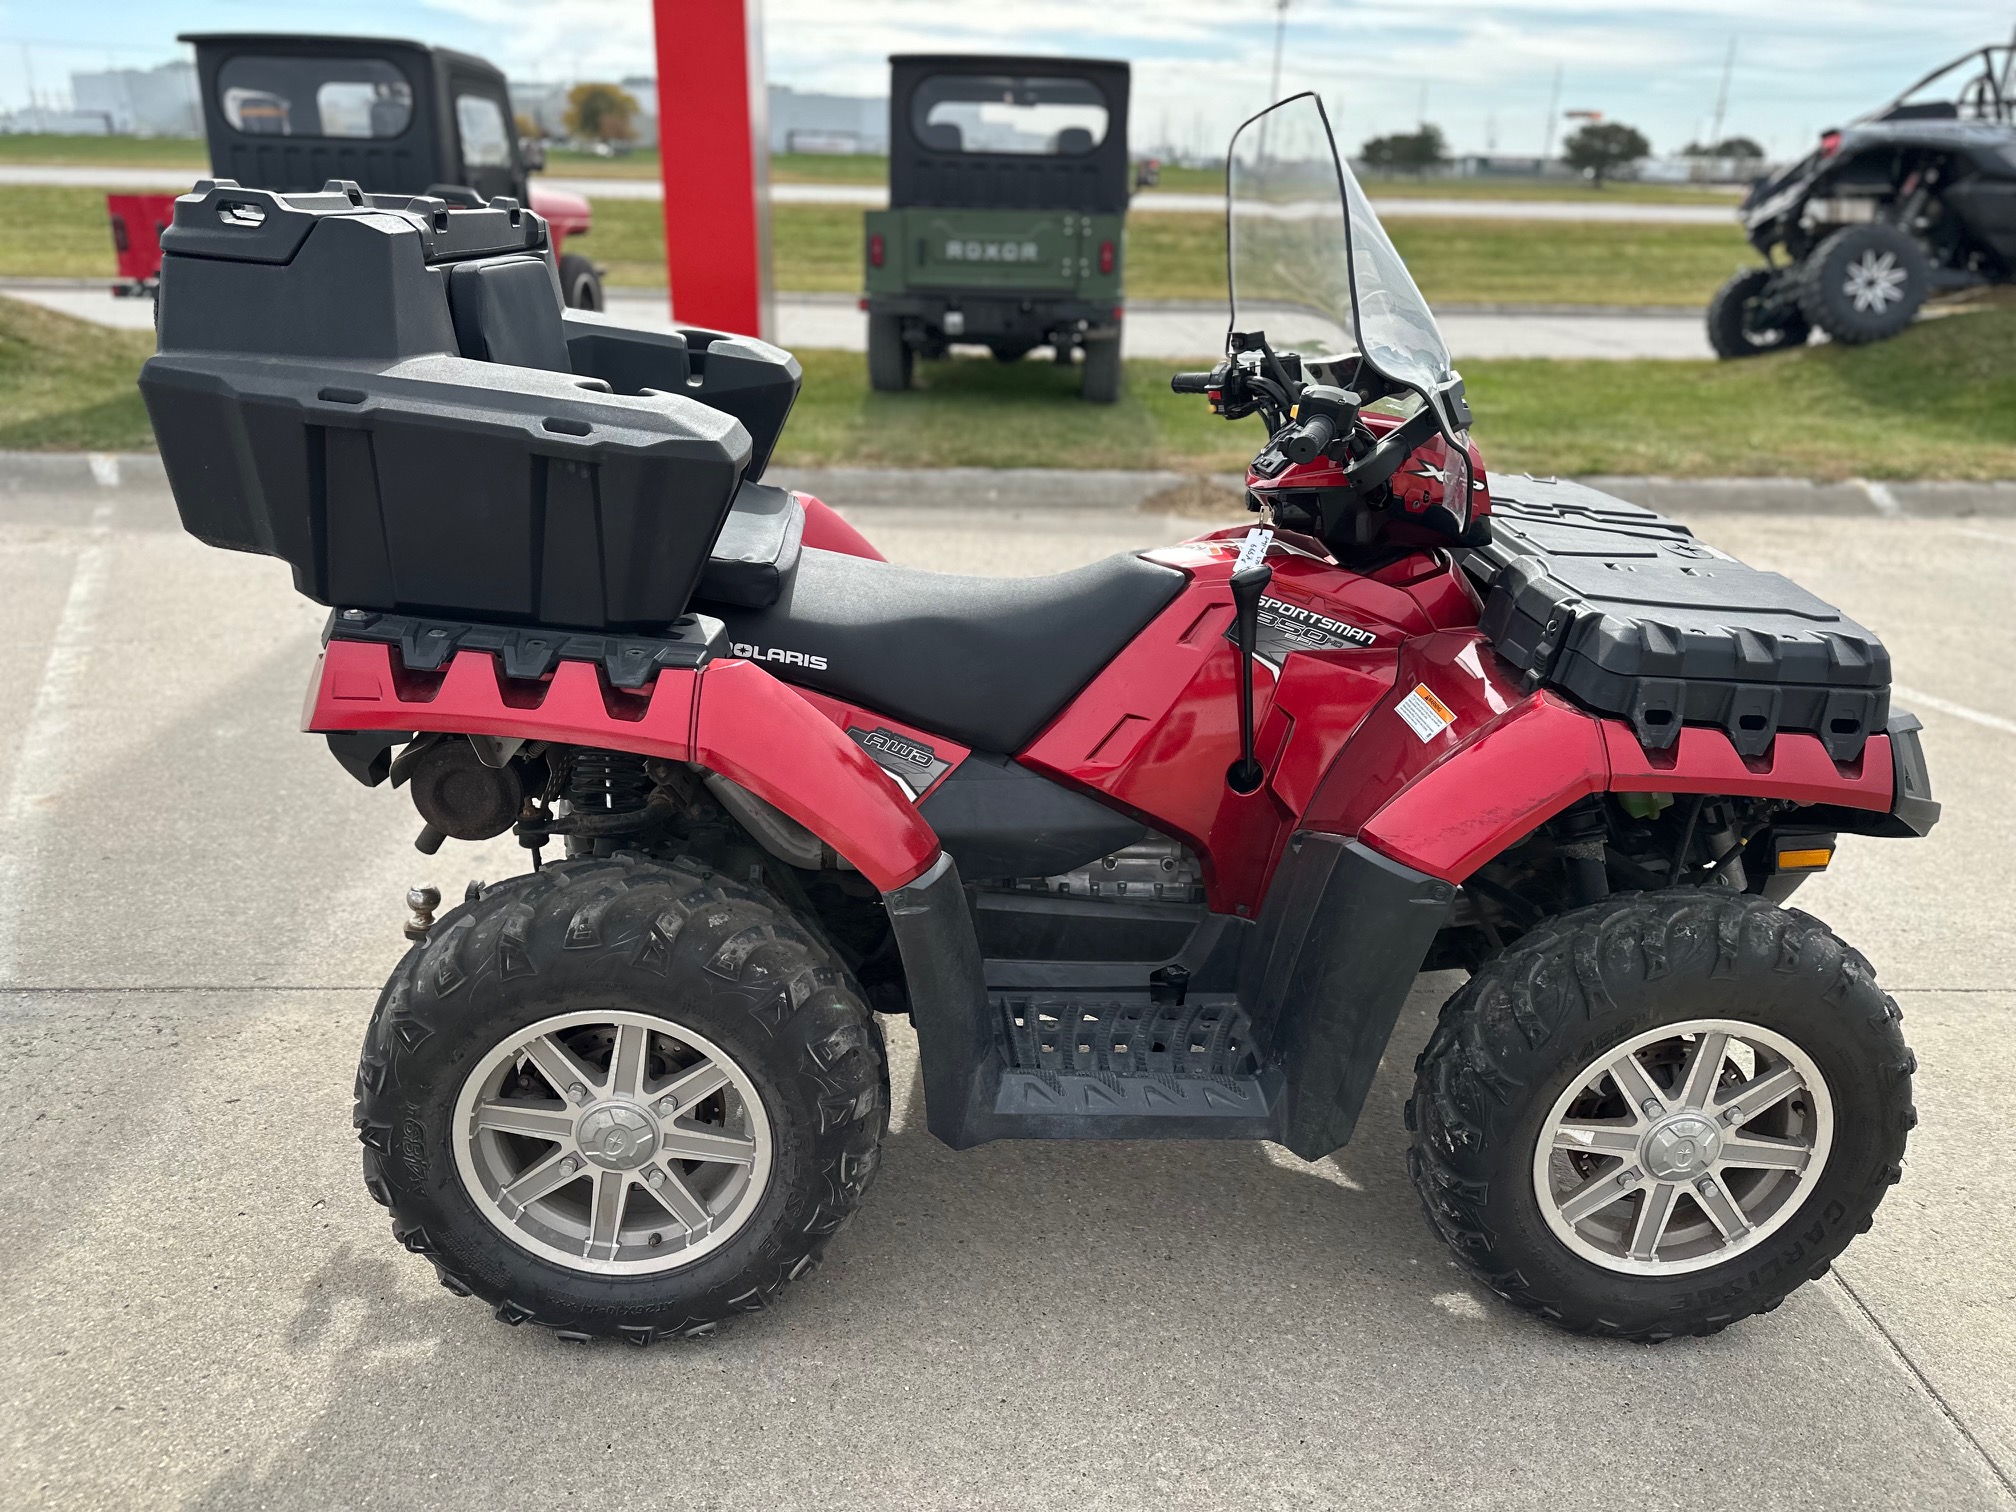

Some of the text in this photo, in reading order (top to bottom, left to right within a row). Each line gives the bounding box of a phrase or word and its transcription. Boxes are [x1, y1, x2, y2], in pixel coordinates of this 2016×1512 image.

[946, 240, 1038, 261] ROXOR
[1258, 595, 1377, 645] SPORTSMAN
[729, 641, 828, 671] OLARIS
[863, 732, 935, 768] AWD
[1670, 1199, 1847, 1311] CARLISLE
